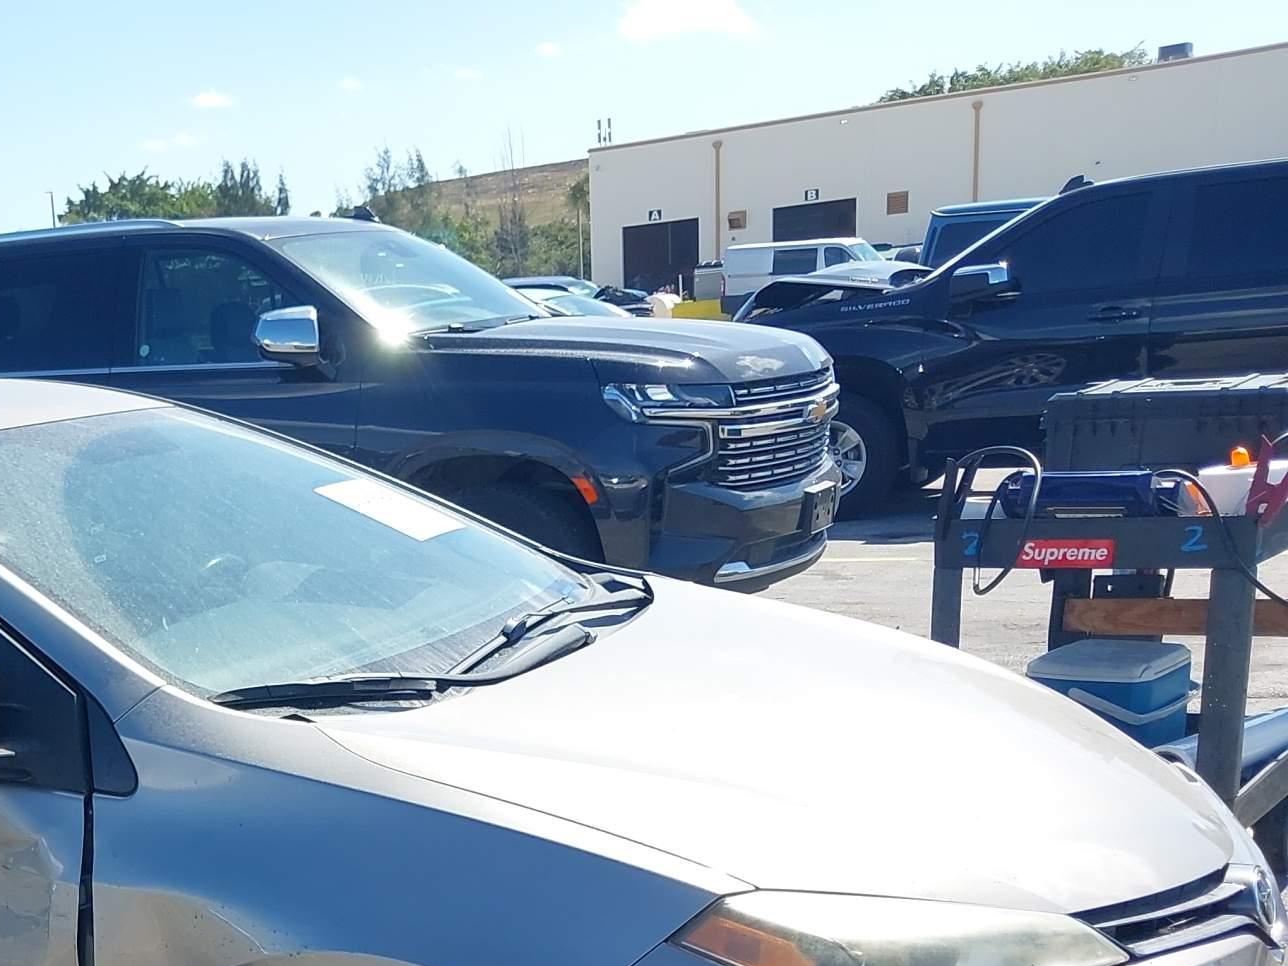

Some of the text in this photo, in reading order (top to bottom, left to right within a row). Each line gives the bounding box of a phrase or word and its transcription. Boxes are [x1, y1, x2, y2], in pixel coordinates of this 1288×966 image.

[807, 190, 817, 200] B
[650, 210, 661, 220] A
[840, 298, 911, 312] SILVERADO
[1180, 525, 1208, 552] 2
[1021, 541, 1109, 565] Supreme
